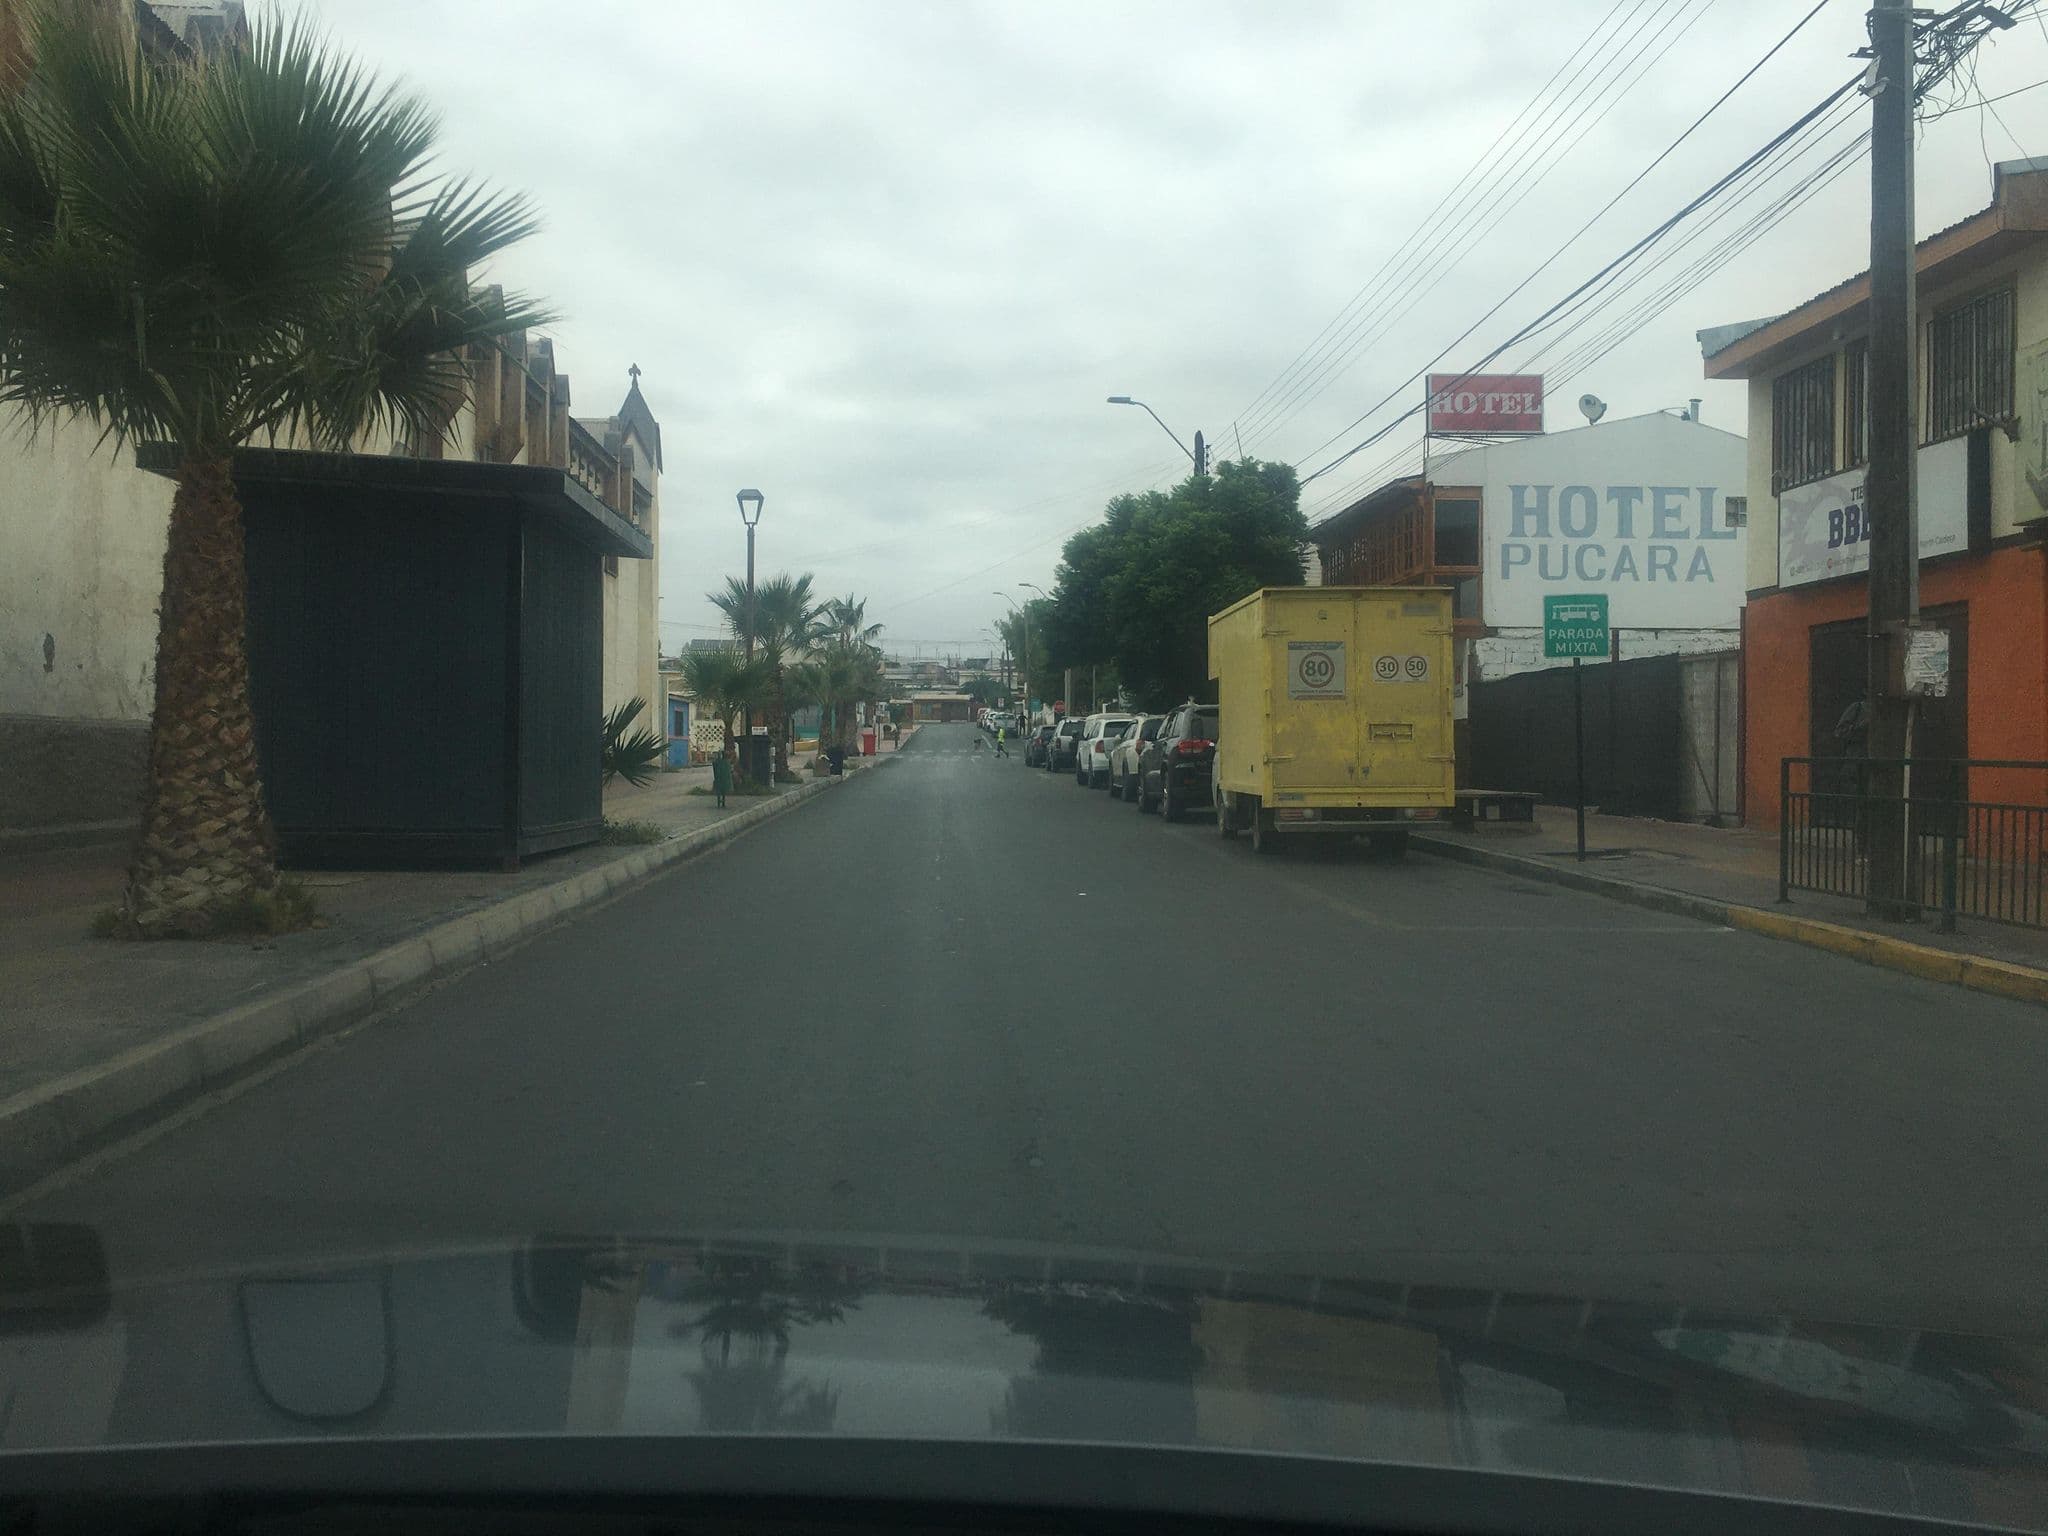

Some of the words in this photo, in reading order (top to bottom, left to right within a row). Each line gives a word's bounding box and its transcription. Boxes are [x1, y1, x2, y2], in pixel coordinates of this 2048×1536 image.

[1431, 392, 1542, 415] HOTEL
[1850, 486, 1865, 501] TIE
[1507, 484, 1738, 540] HOTEL
[1500, 543, 1715, 583] PUCARA
[1549, 627, 1604, 640] PARADA
[1555, 641, 1598, 653] MIXTA
[1304, 660, 1330, 677] 80
[1379, 661, 1395, 673] 30
[1408, 660, 1424, 671] 50
